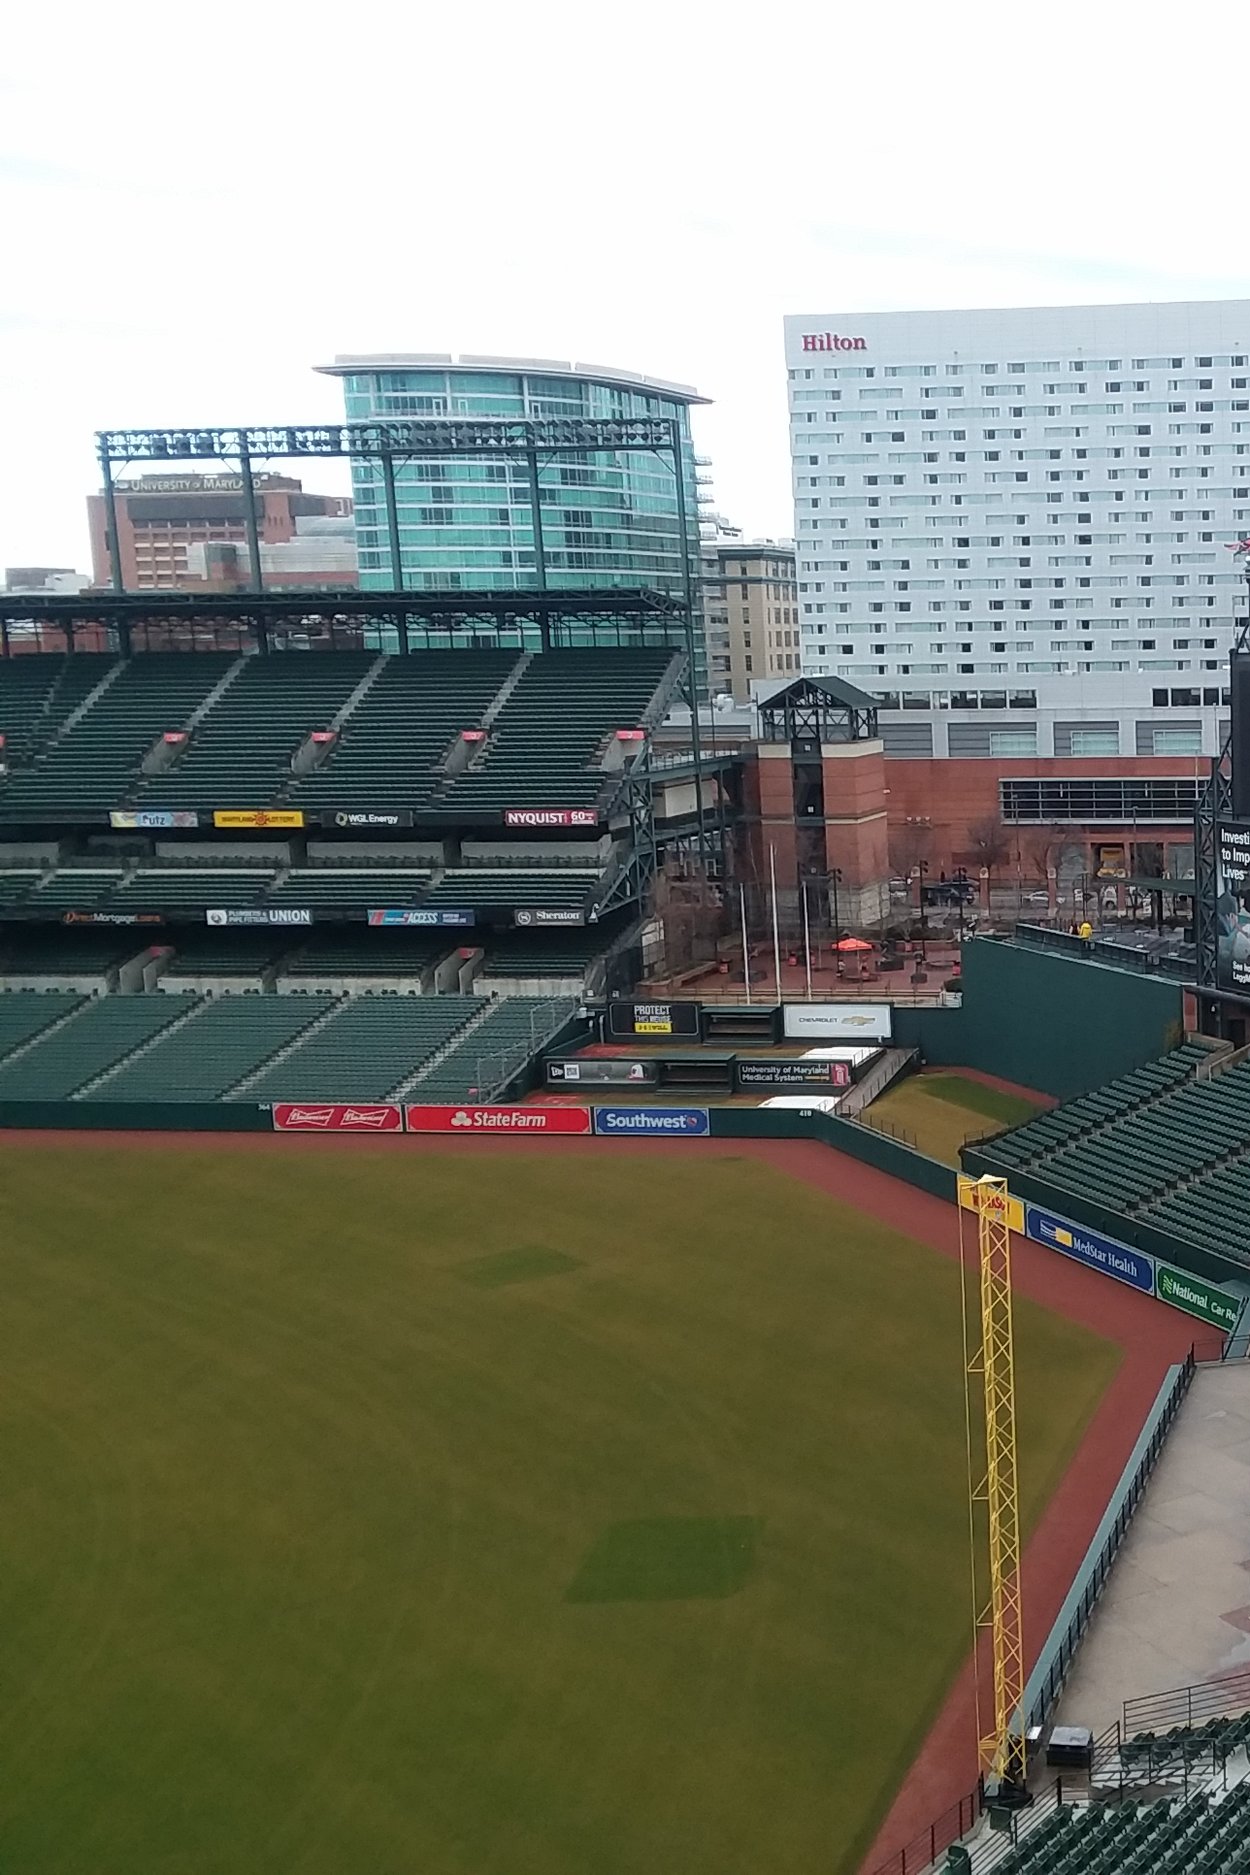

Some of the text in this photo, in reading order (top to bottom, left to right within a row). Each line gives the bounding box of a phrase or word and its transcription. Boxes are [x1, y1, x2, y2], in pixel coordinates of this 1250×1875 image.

[801, 332, 867, 352] Hilton
[203, 478, 261, 490] MARYLAD
[349, 814, 398, 825] WGL Energy
[508, 812, 564, 824] NYQUIST
[1221, 848, 1232, 861] to
[269, 910, 310, 922] UNION
[536, 911, 581, 921] Sheraton
[634, 1005, 671, 1015] PROTECT
[742, 1066, 781, 1075] University
[793, 1064, 830, 1075] Maryland
[774, 1074, 803, 1082] System
[606, 1112, 688, 1129] Southwest
[1073, 1237, 1137, 1278] MedStar Health
[1172, 1281, 1208, 1309] National
[1210, 1302, 1225, 1317] Car
